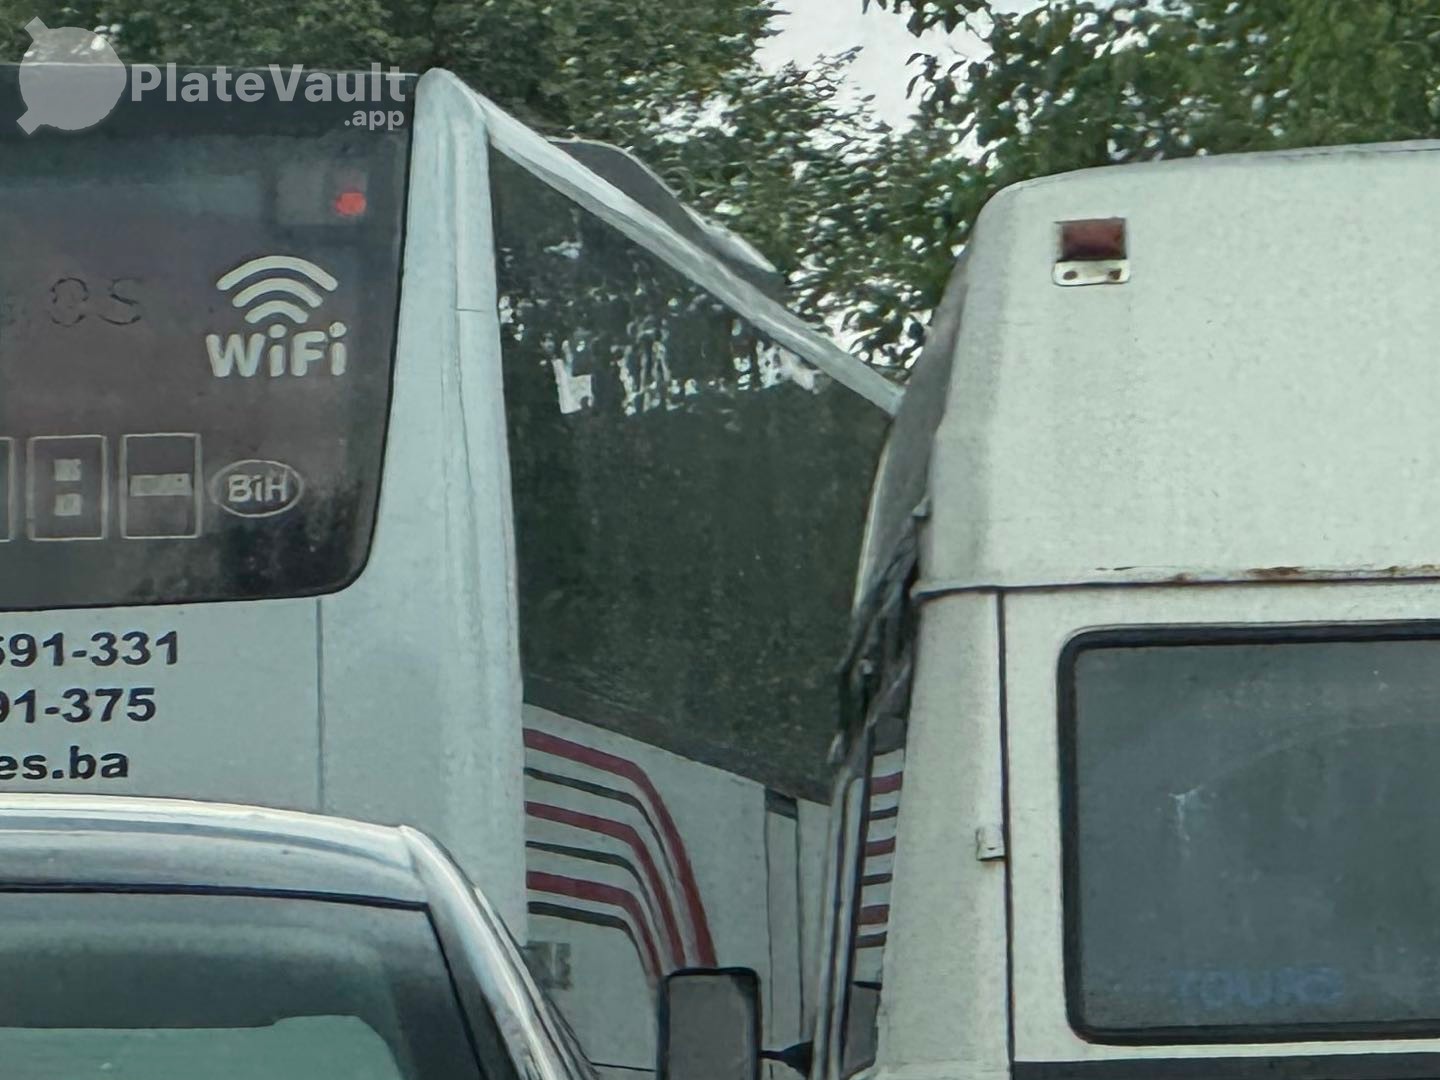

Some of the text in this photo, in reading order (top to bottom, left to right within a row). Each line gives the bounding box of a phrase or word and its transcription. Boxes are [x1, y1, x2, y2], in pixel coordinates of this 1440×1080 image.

[205, 322, 347, 377] WiFi
[227, 473, 289, 502] BiH
[0, 630, 178, 667] 91-331
[0, 745, 129, 780] es.ba
